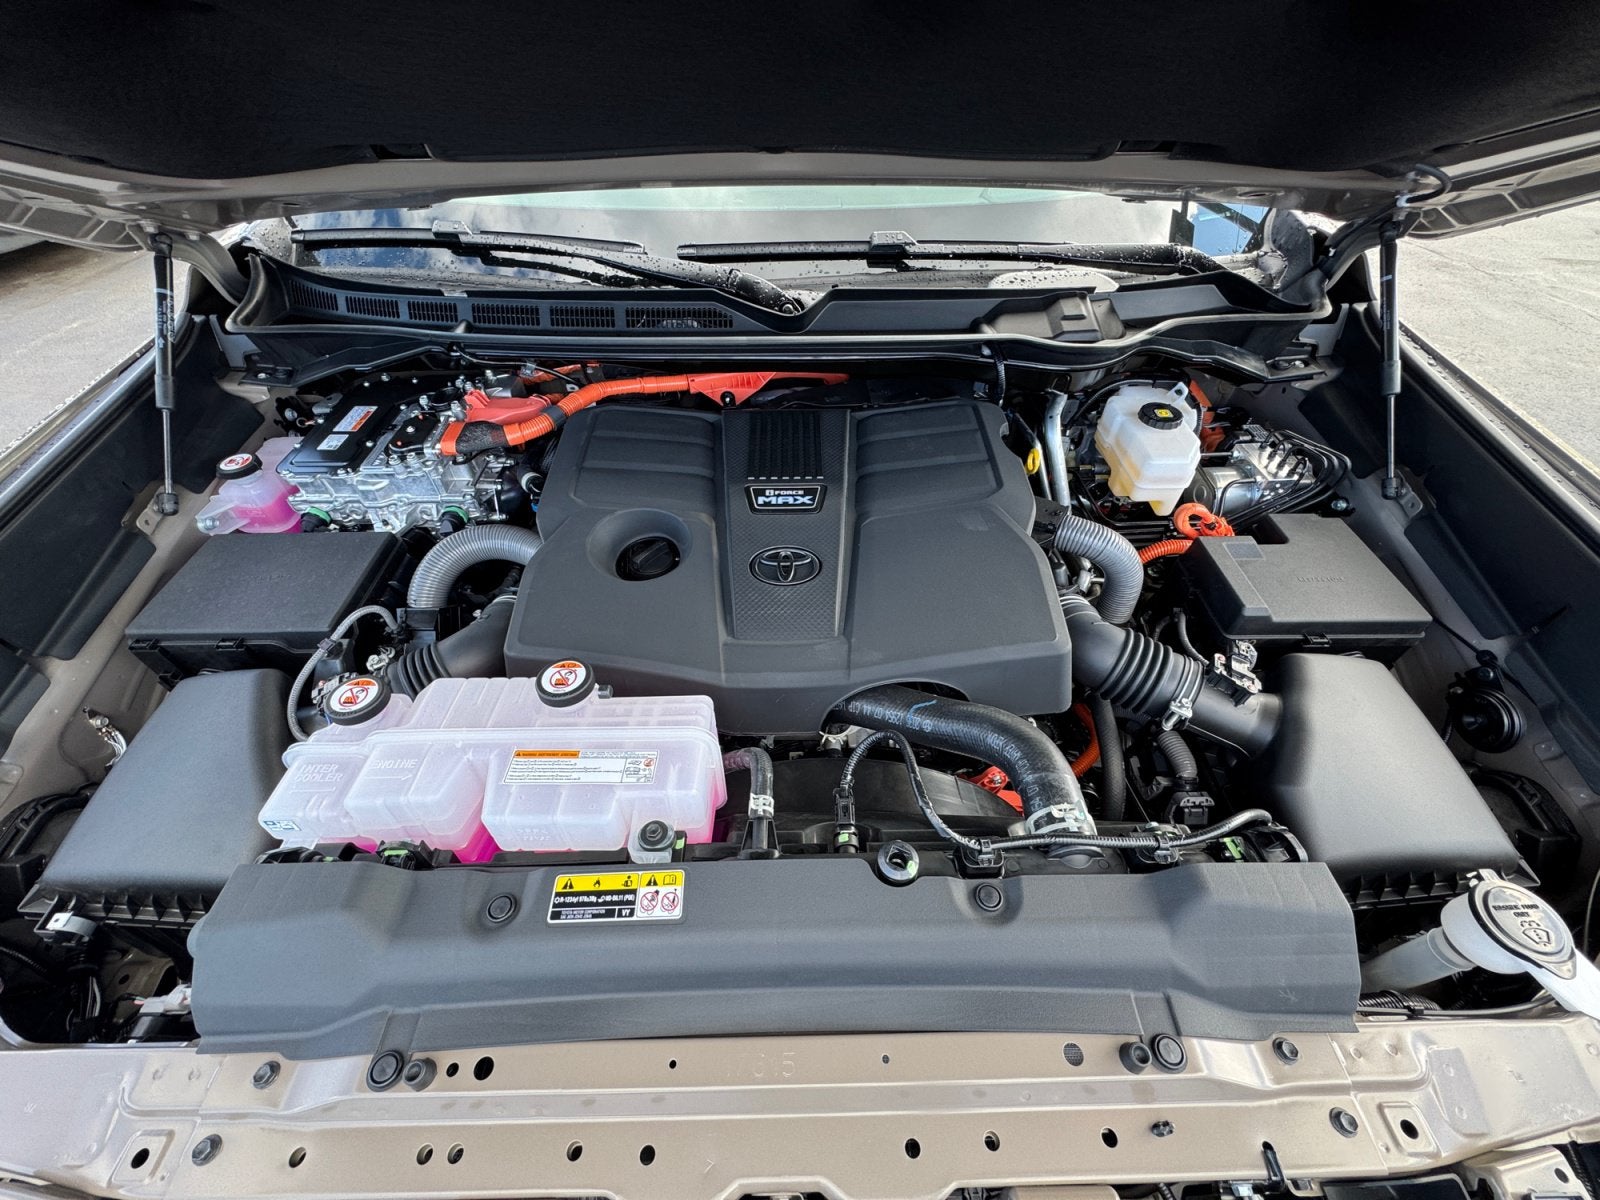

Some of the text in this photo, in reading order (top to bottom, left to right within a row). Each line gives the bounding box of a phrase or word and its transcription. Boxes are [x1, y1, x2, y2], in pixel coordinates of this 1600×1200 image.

[757, 495, 814, 505] MAX
[300, 763, 338, 773] INTER
[372, 759, 418, 769] ENGINE
[296, 773, 343, 782] COOLER
